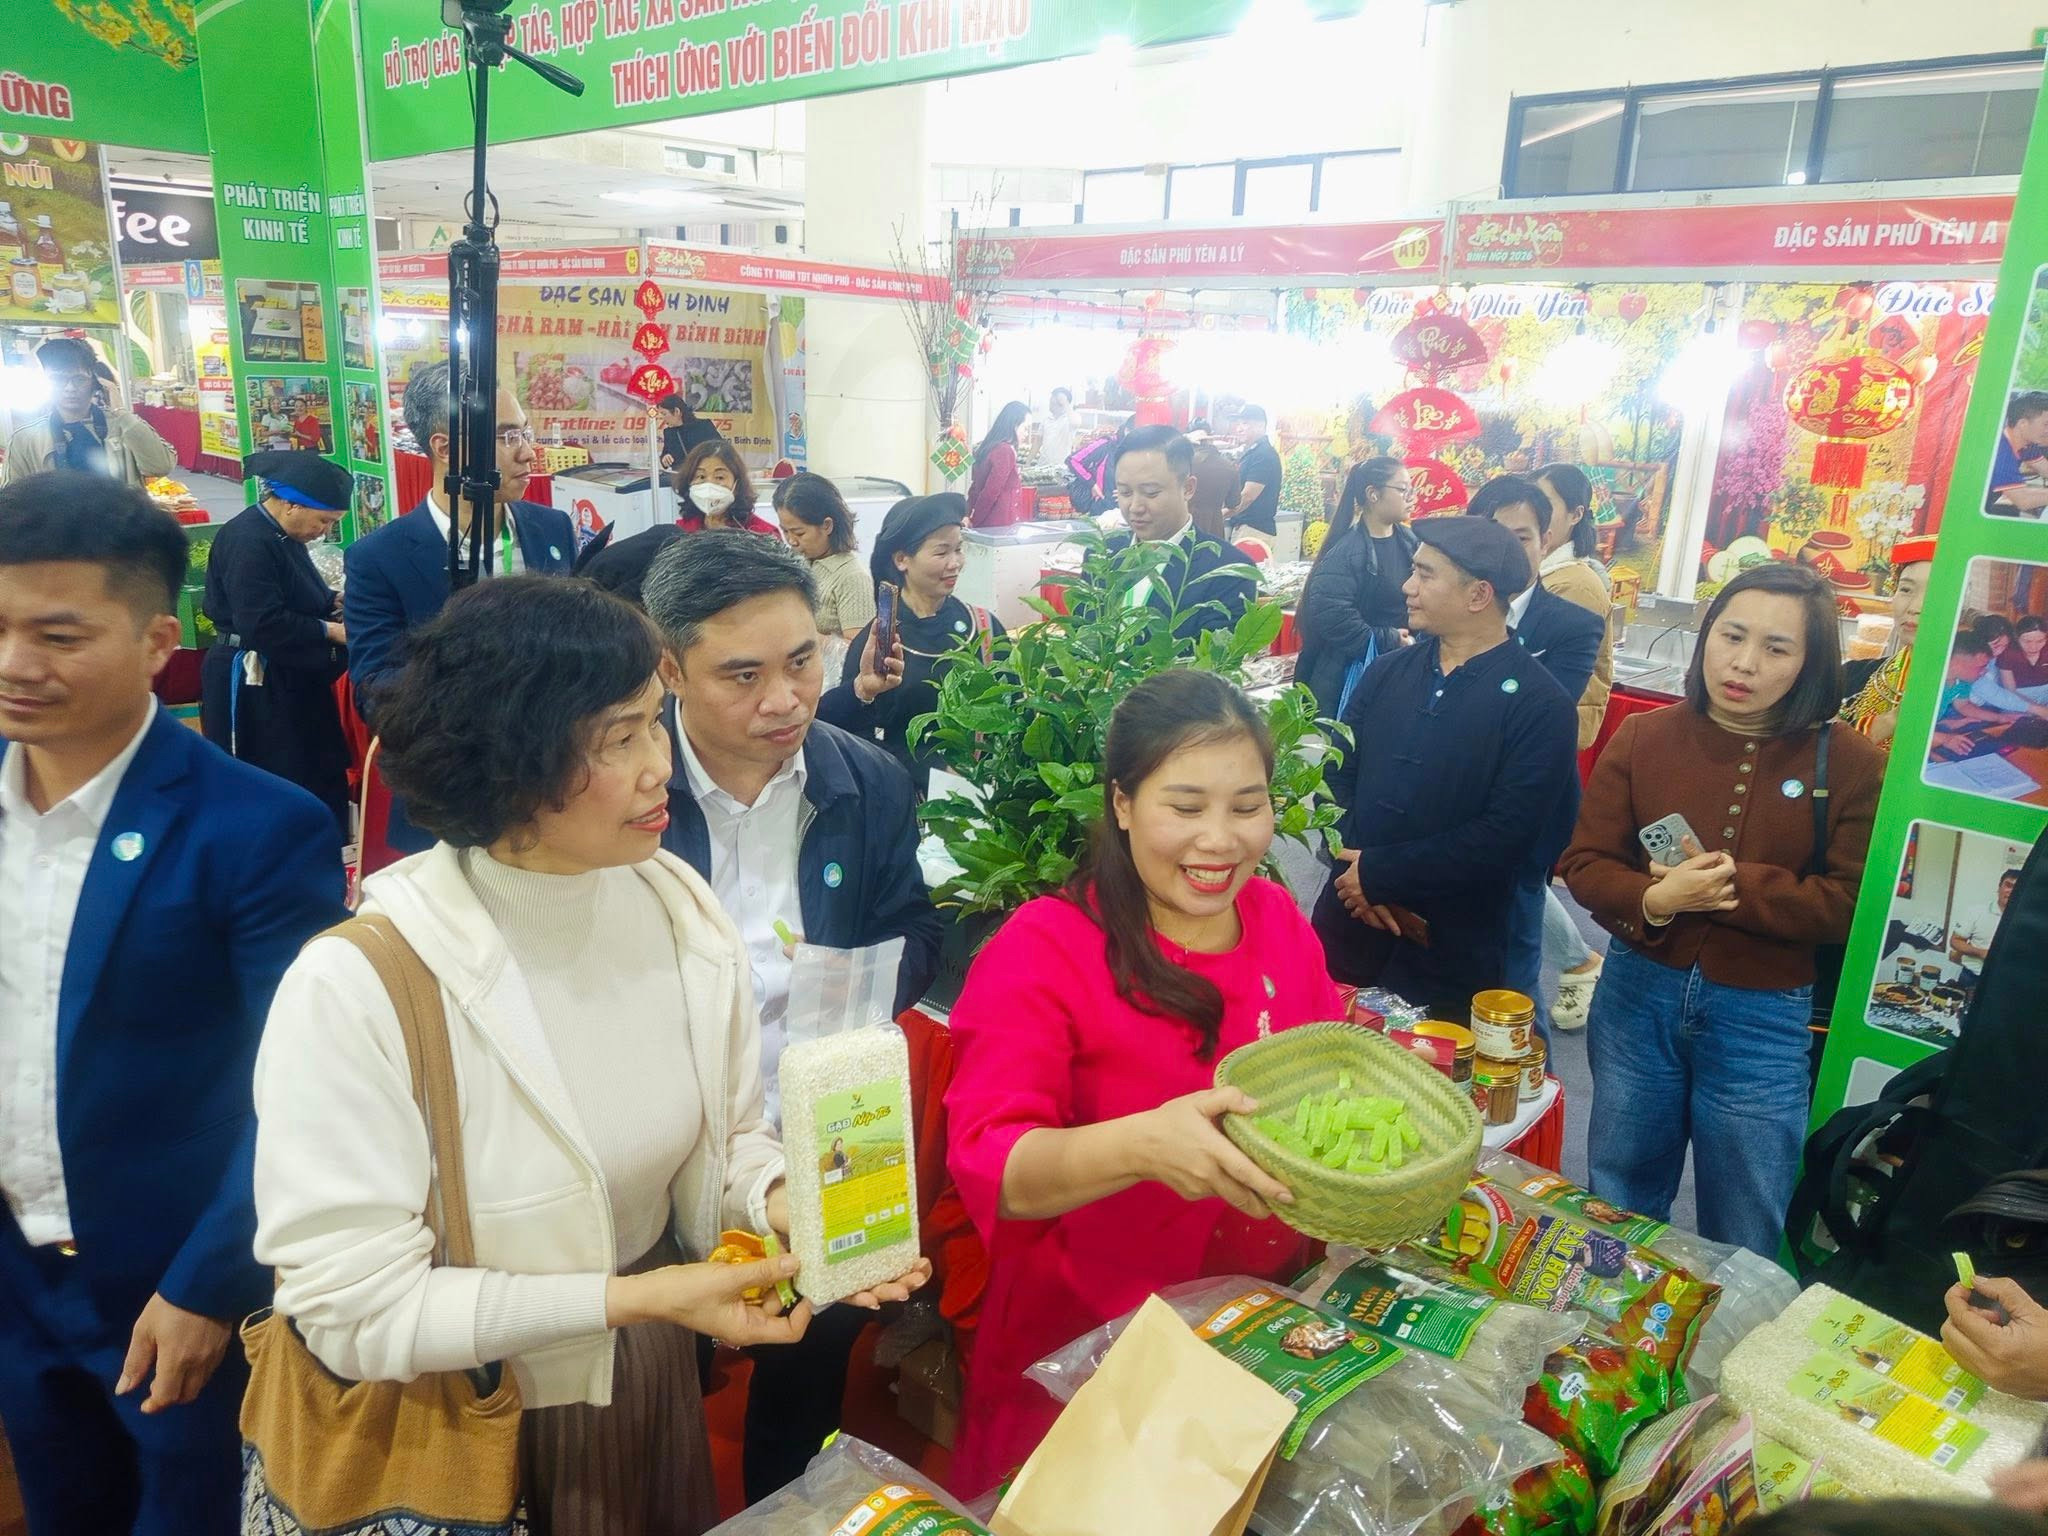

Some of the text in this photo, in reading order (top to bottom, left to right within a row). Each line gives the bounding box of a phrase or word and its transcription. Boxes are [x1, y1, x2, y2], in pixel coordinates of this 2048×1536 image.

[561, 0, 599, 54] HỢP
[404, 40, 429, 88] TRỢ
[432, 30, 460, 76] CÁC
[612, 50, 670, 107] THÍCH
[675, 40, 721, 96] ỨNG
[726, 25, 766, 88] VỚI
[772, 6, 834, 80] BIẾN
[3, 160, 53, 189] NÚI
[223, 181, 321, 213] PHÁT TRIỂN
[243, 217, 309, 243] KINH TẾ
[1773, 217, 1999, 252] ĐẶC SẢN PHÚ YÊN A
[1120, 242, 1246, 268] ĐẶC SẢN PHÚ YÊN A LÝ
[740, 264, 763, 278] CÔNG
[764, 268, 774, 279] TY
[686, 293, 730, 317] ĐỊNH
[539, 315, 584, 337] RAM
[613, 434, 630, 445] các
[1552, 1220, 1591, 1263] TÀI
[1363, 1290, 1399, 1326] Dong
